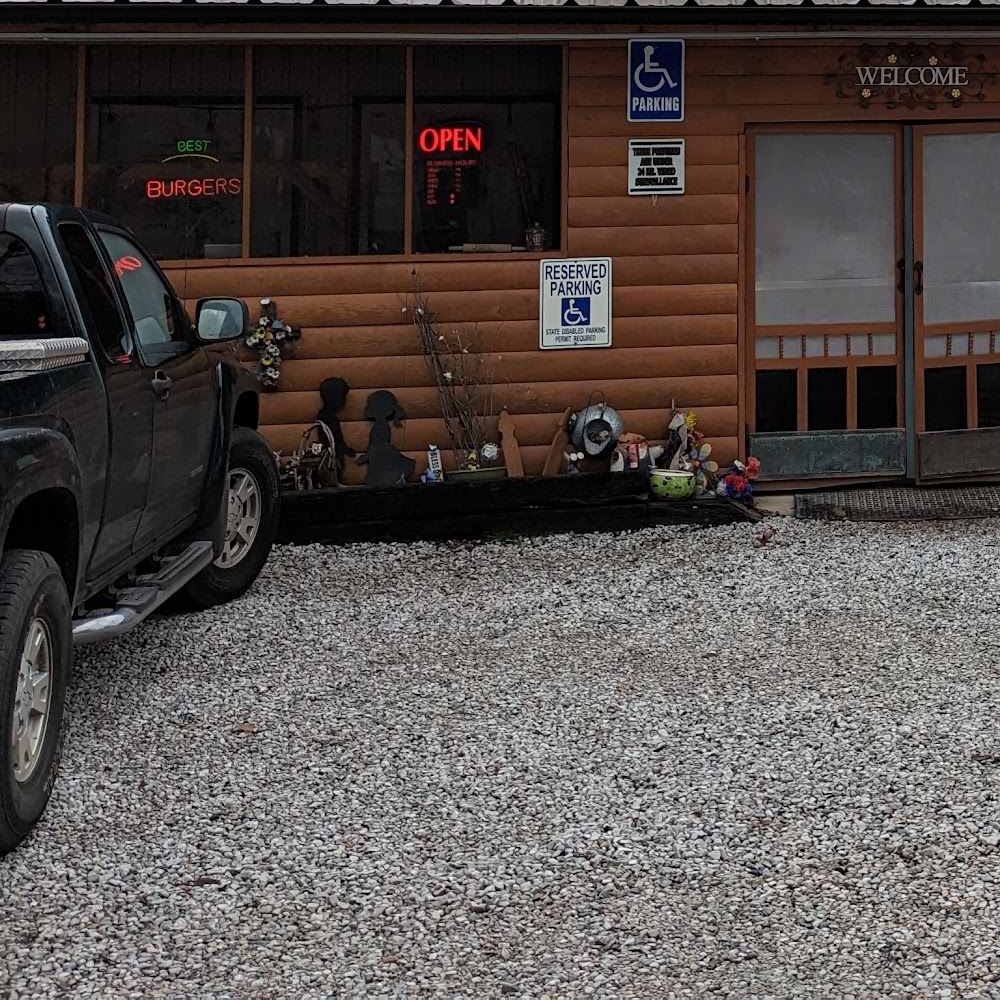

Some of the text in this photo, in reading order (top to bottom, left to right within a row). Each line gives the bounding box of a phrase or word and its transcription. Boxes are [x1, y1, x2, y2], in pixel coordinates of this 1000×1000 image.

[855, 66, 968, 86] WELCOME
[632, 97, 680, 112] PARKING
[419, 127, 483, 153] OPEN
[146, 178, 242, 199] BURGERS
[545, 263, 607, 280] RESERVED
[550, 280, 601, 296] PARKING
[545, 326, 606, 336] STATE DISABLED PARKING
